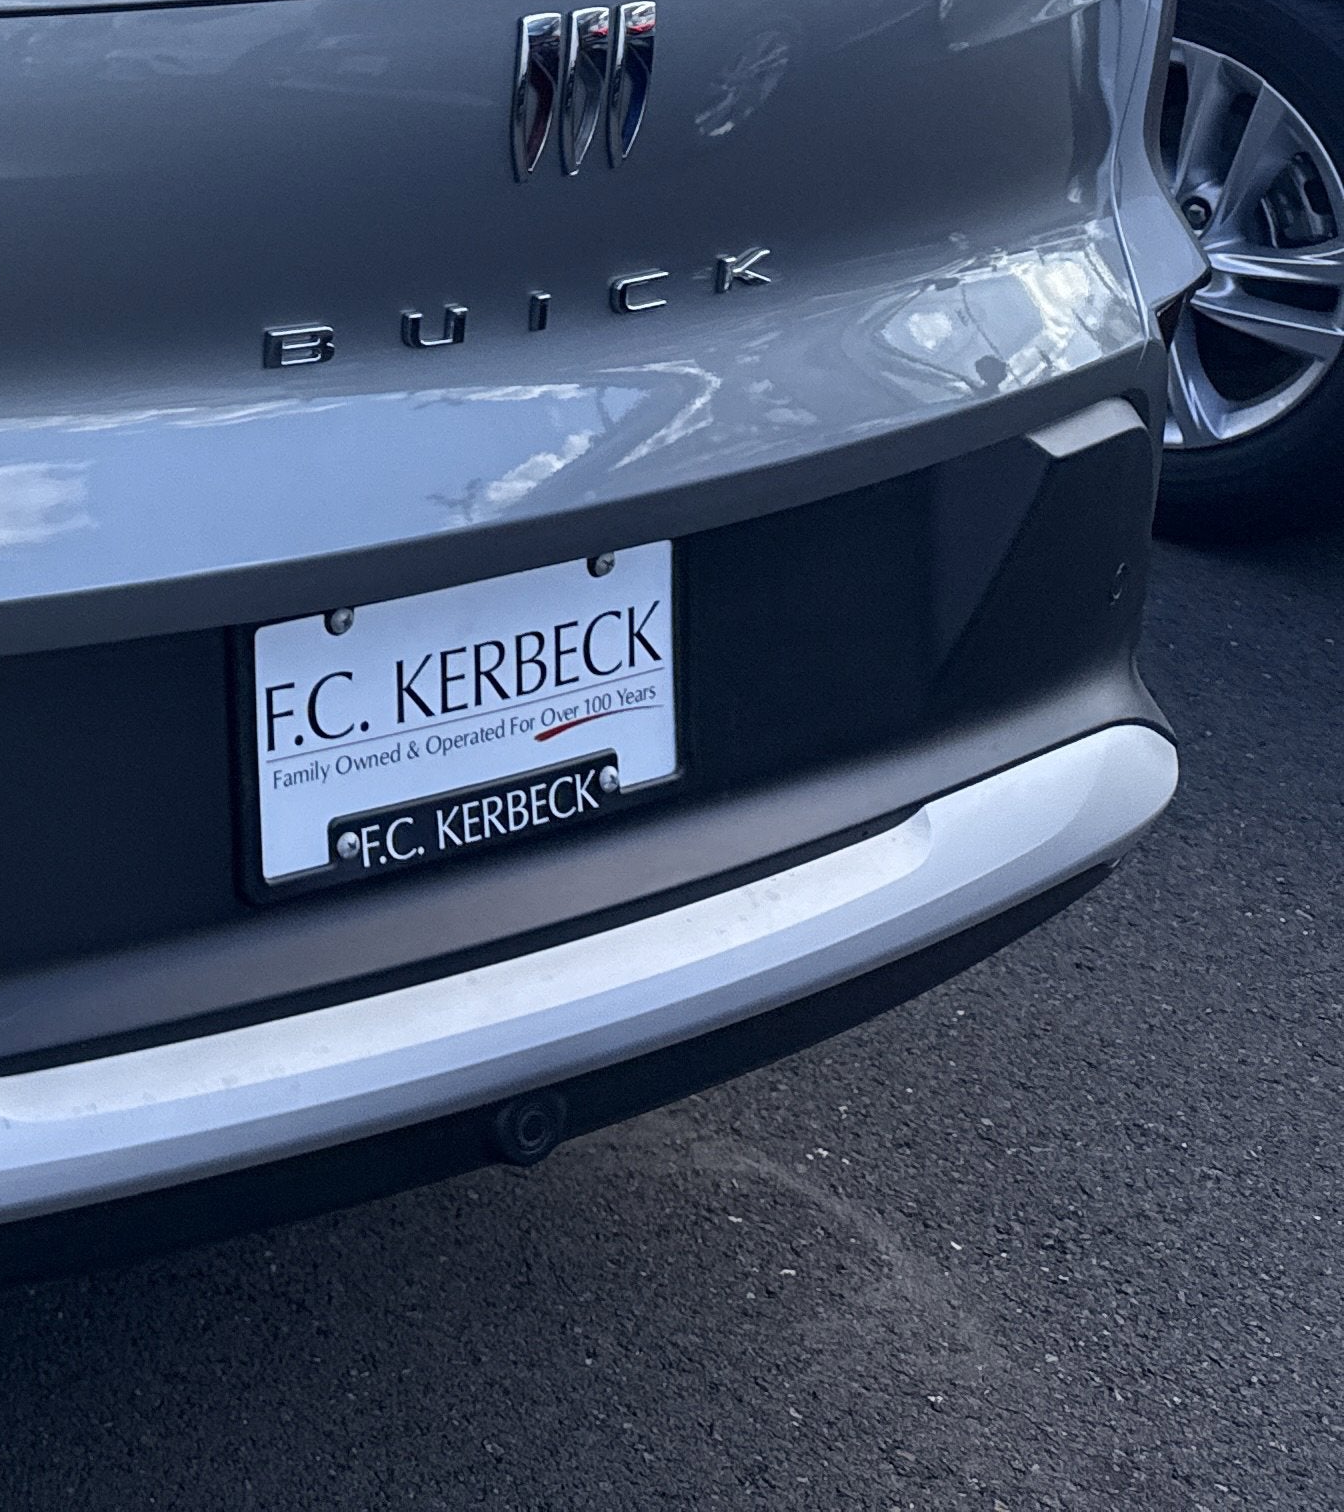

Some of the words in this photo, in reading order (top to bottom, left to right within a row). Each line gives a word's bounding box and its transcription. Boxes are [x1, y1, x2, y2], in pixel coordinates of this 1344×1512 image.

[263, 247, 772, 369] BUICK
[265, 670, 370, 752] F.C.
[396, 600, 662, 724] KERBECK
[272, 760, 331, 790] Family
[335, 738, 402, 775] Owned
[406, 740, 421, 760] &
[425, 714, 506, 756] Operated
[509, 714, 535, 737] For
[540, 703, 580, 728] Over
[584, 692, 612, 716] 100
[617, 684, 657, 708] Years
[360, 817, 425, 867] F.C.
[436, 768, 599, 850] KERBECK
